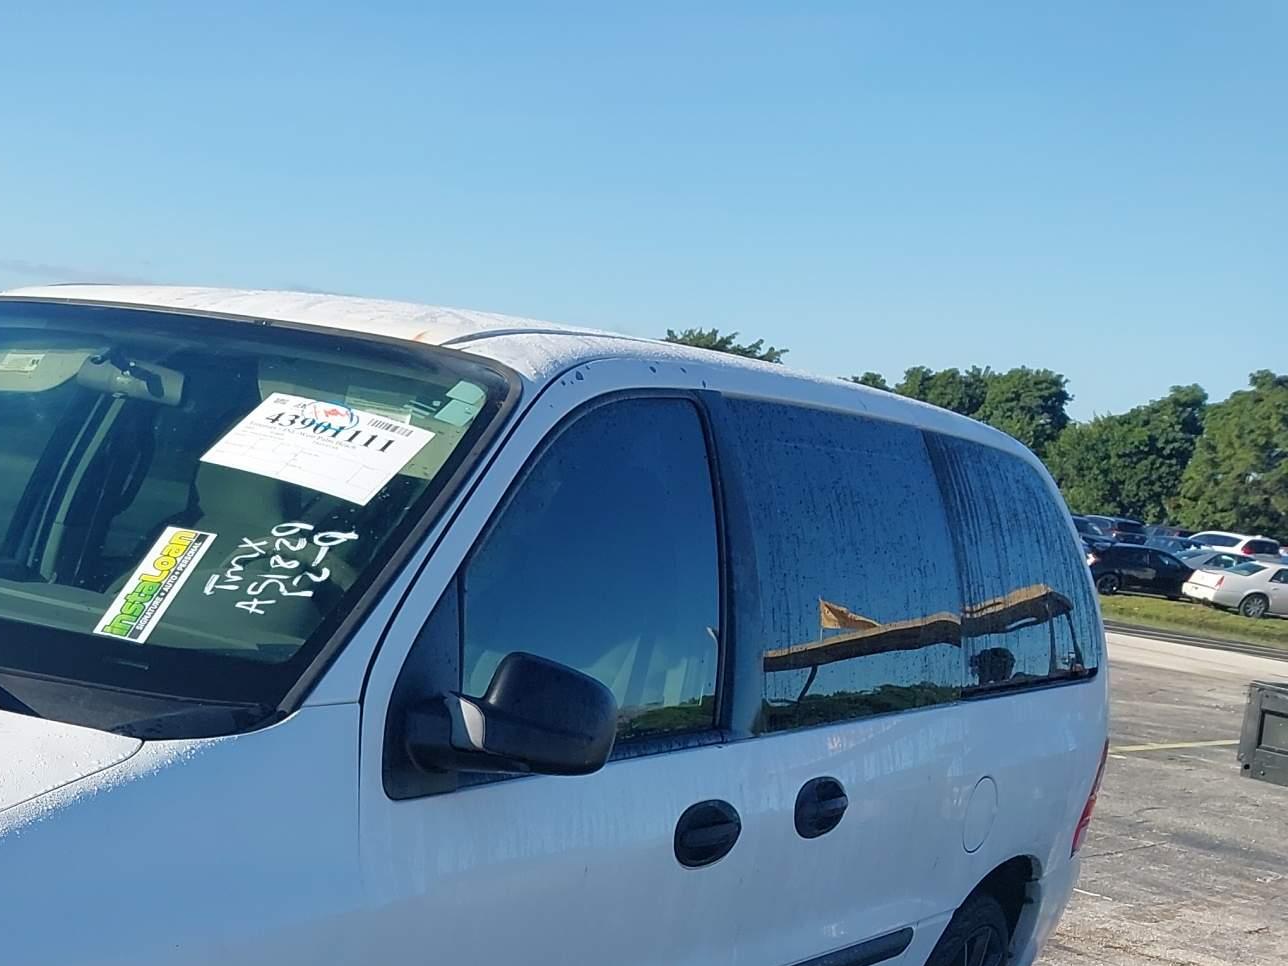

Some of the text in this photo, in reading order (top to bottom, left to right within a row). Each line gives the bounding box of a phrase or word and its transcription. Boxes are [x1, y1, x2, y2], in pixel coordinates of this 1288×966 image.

[266, 411, 395, 453] 43901111
[136, 541, 202, 631] SIGNATURE AUTO PERSONAL
